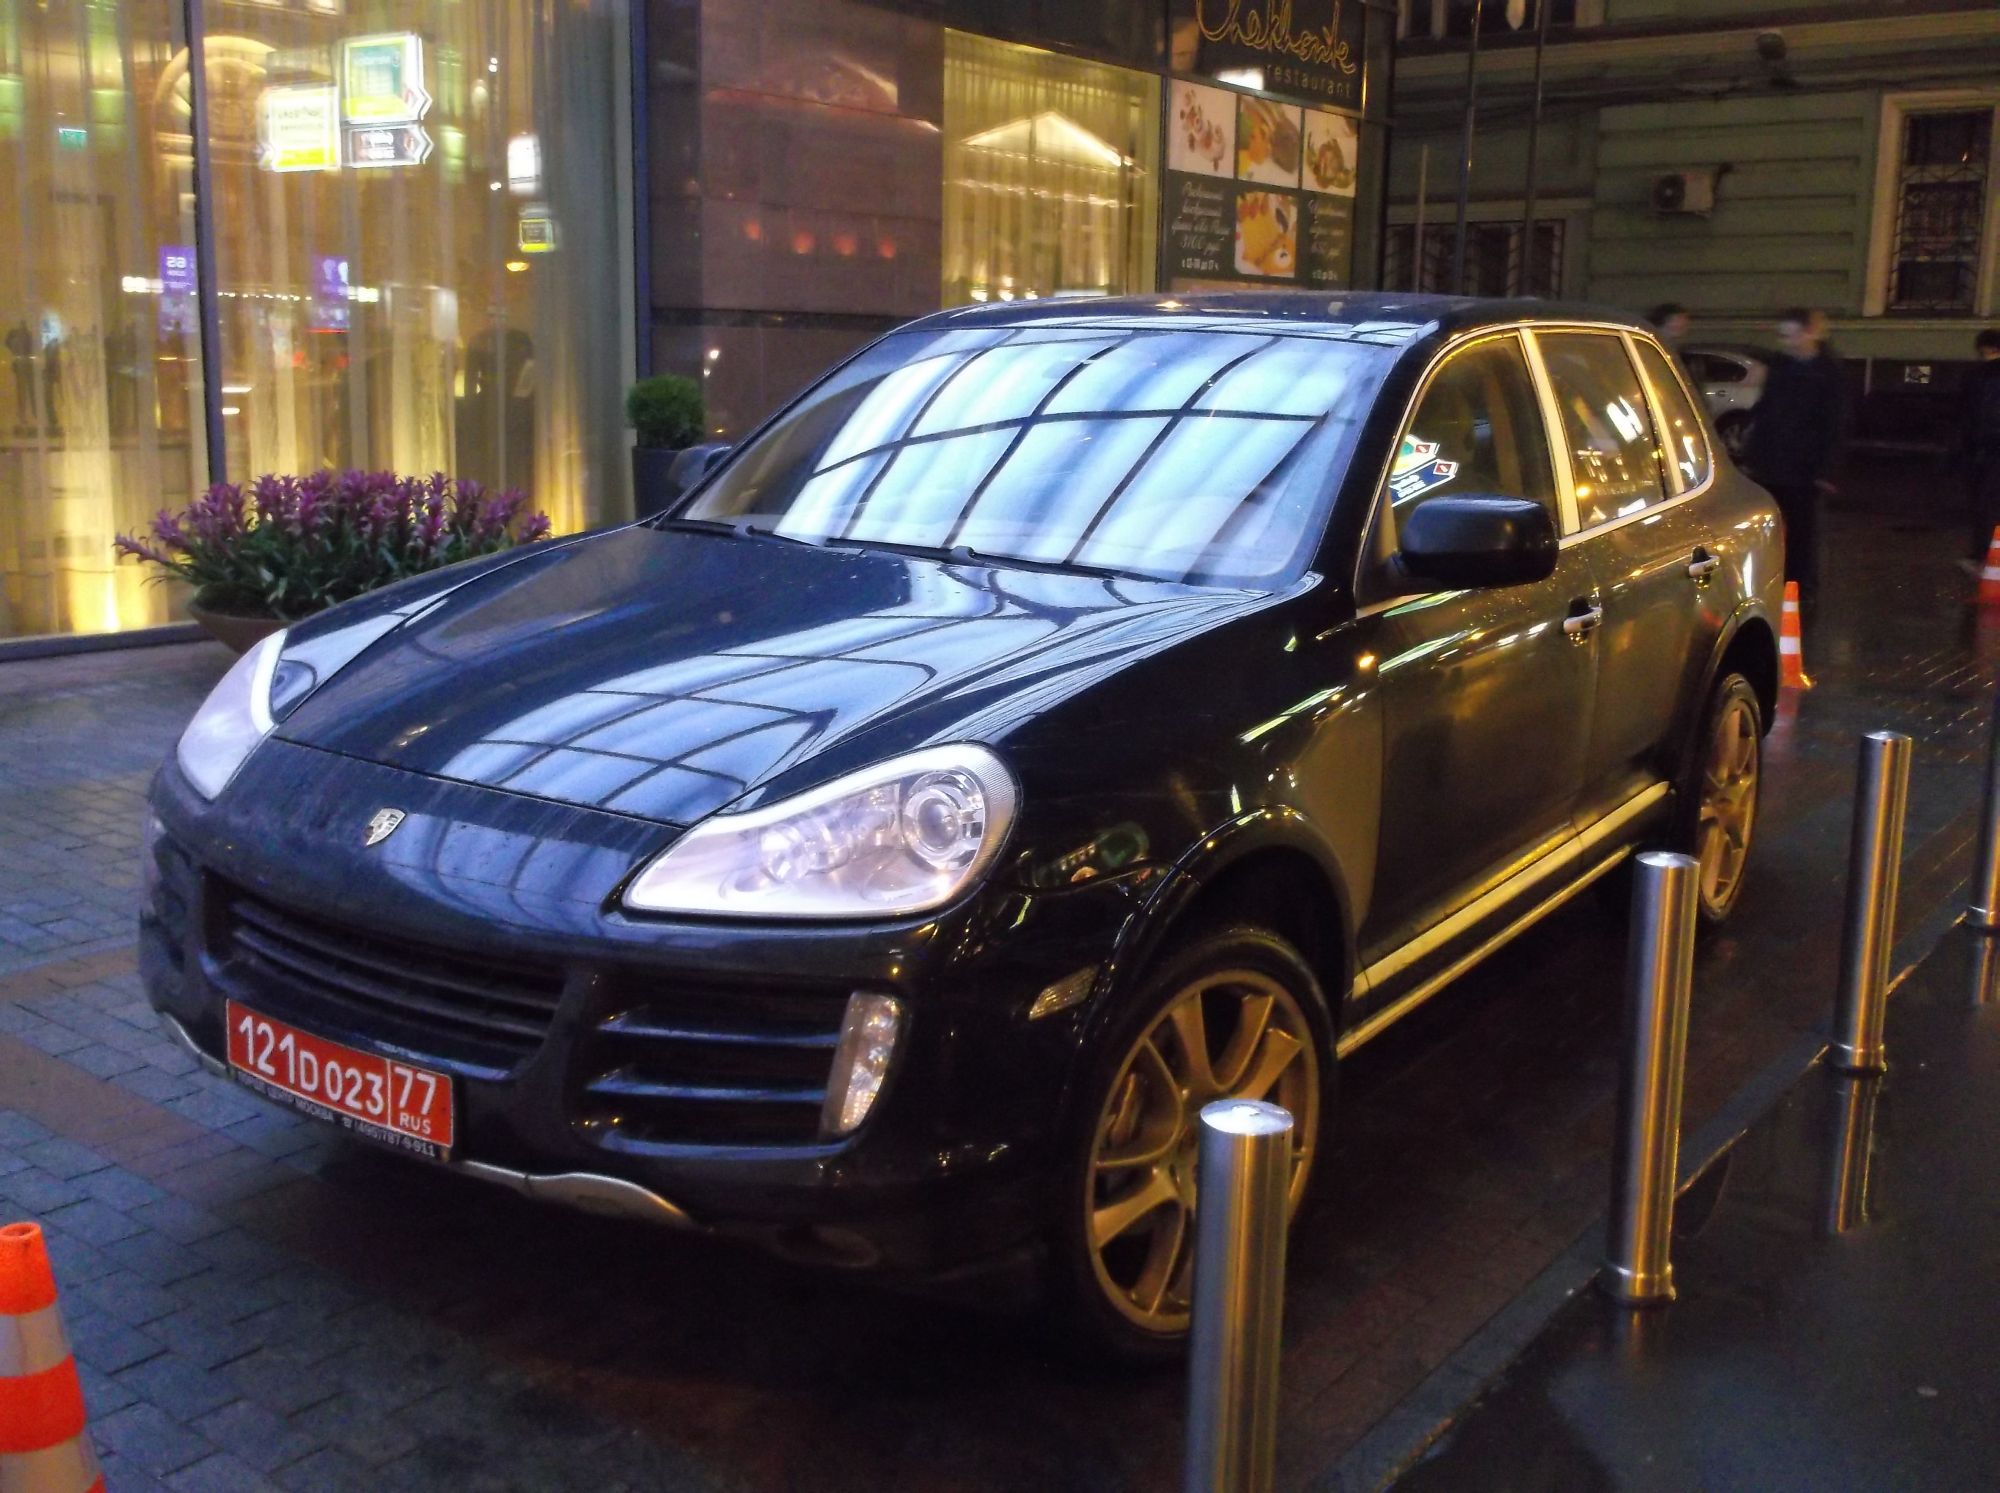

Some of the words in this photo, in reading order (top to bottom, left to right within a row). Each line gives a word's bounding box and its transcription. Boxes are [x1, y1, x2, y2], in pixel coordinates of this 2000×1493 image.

[1265, 63, 1352, 98] restaurant
[393, 1066, 436, 1115] 77
[400, 1113, 431, 1135] RUS
